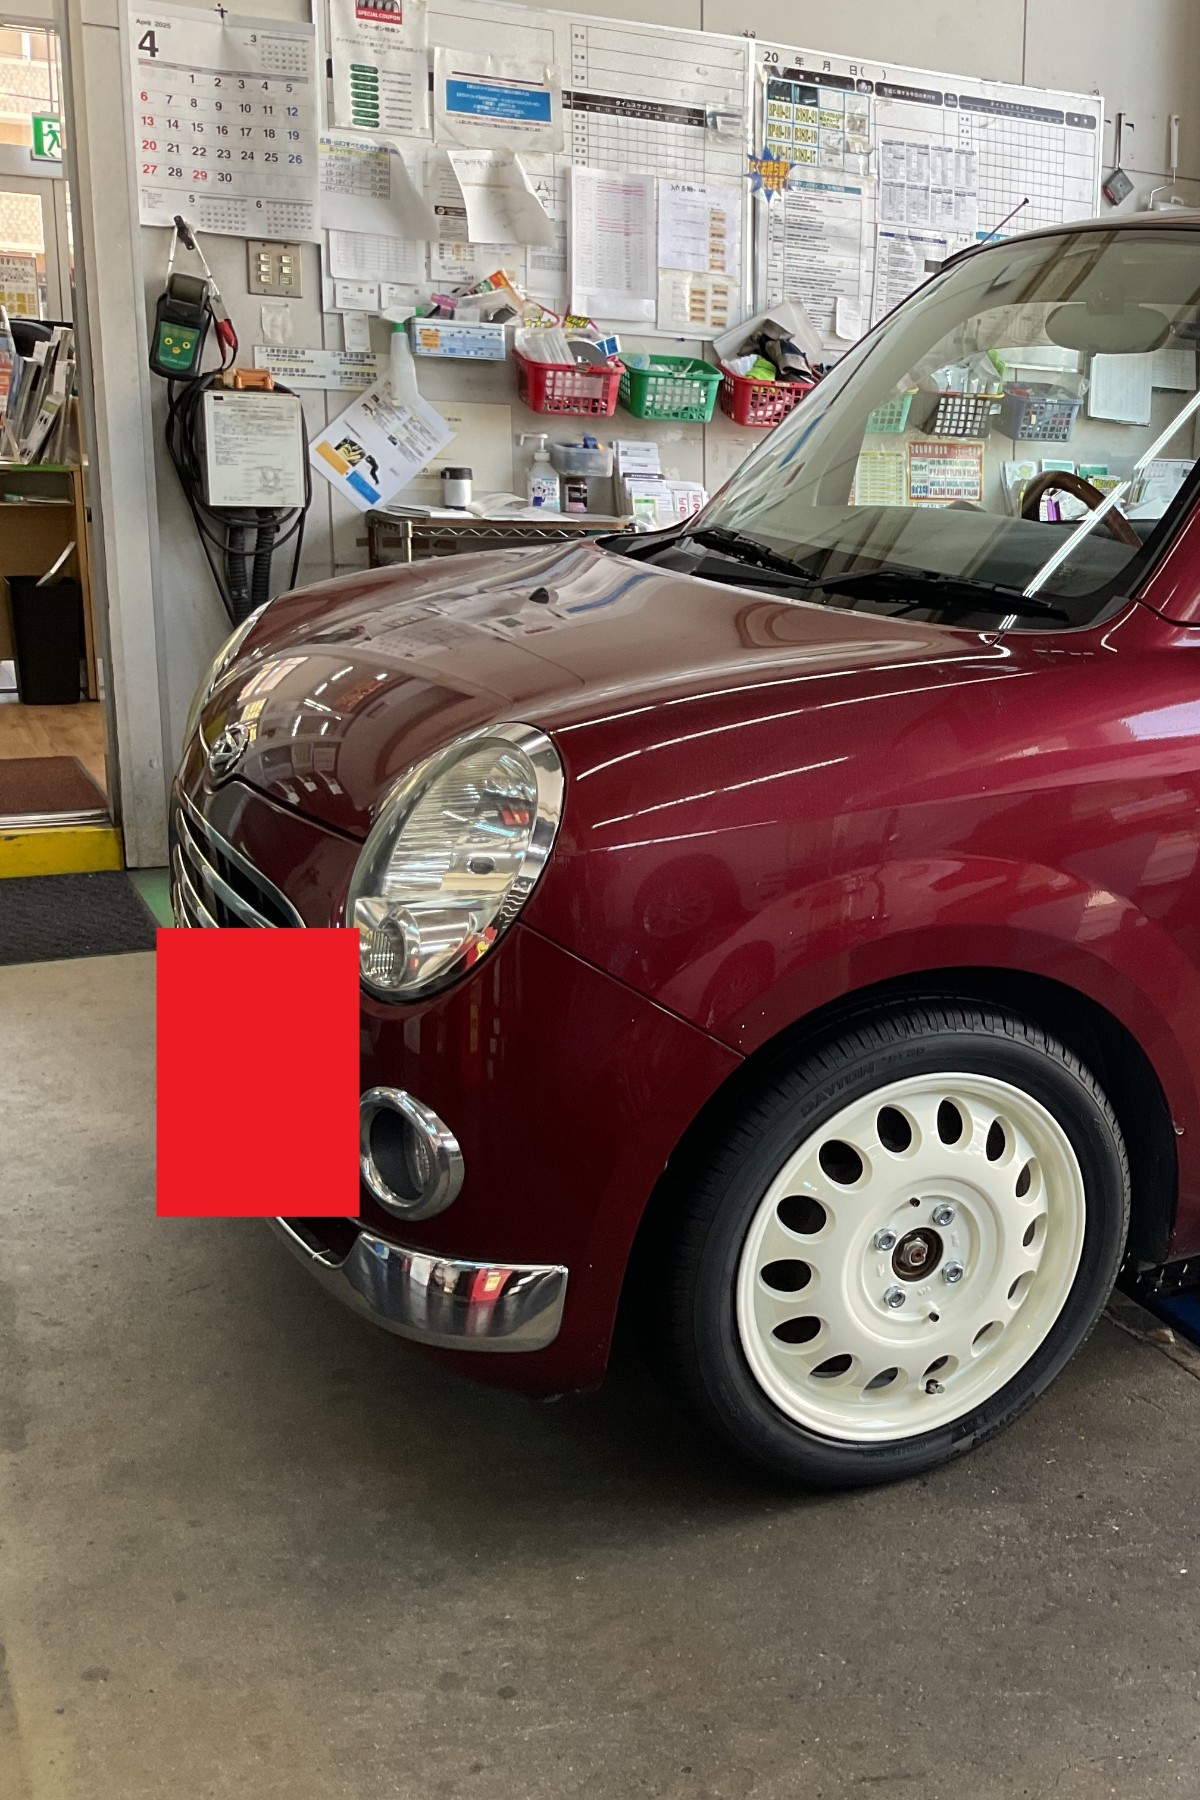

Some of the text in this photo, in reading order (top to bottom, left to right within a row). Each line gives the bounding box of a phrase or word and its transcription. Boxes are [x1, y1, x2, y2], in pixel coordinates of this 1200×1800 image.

[358, 10, 401, 21] SPECIAL COUPON
[138, 30, 159, 58] 4
[764, 51, 779, 63] 20
[795, 56, 804, 67] 年
[822, 61, 831, 72] 月
[190, 75, 292, 92] 1 2 3 4 5
[141, 92, 298, 116] 6 7 8 9 10 11 12
[142, 116, 299, 140] 13 14 15 16 17 18 19
[143, 140, 302, 164] 20 21 22 23 24 25 26
[143, 164, 232, 183] 27 28 29 30
[800, 1062, 875, 1118] DAYTON
